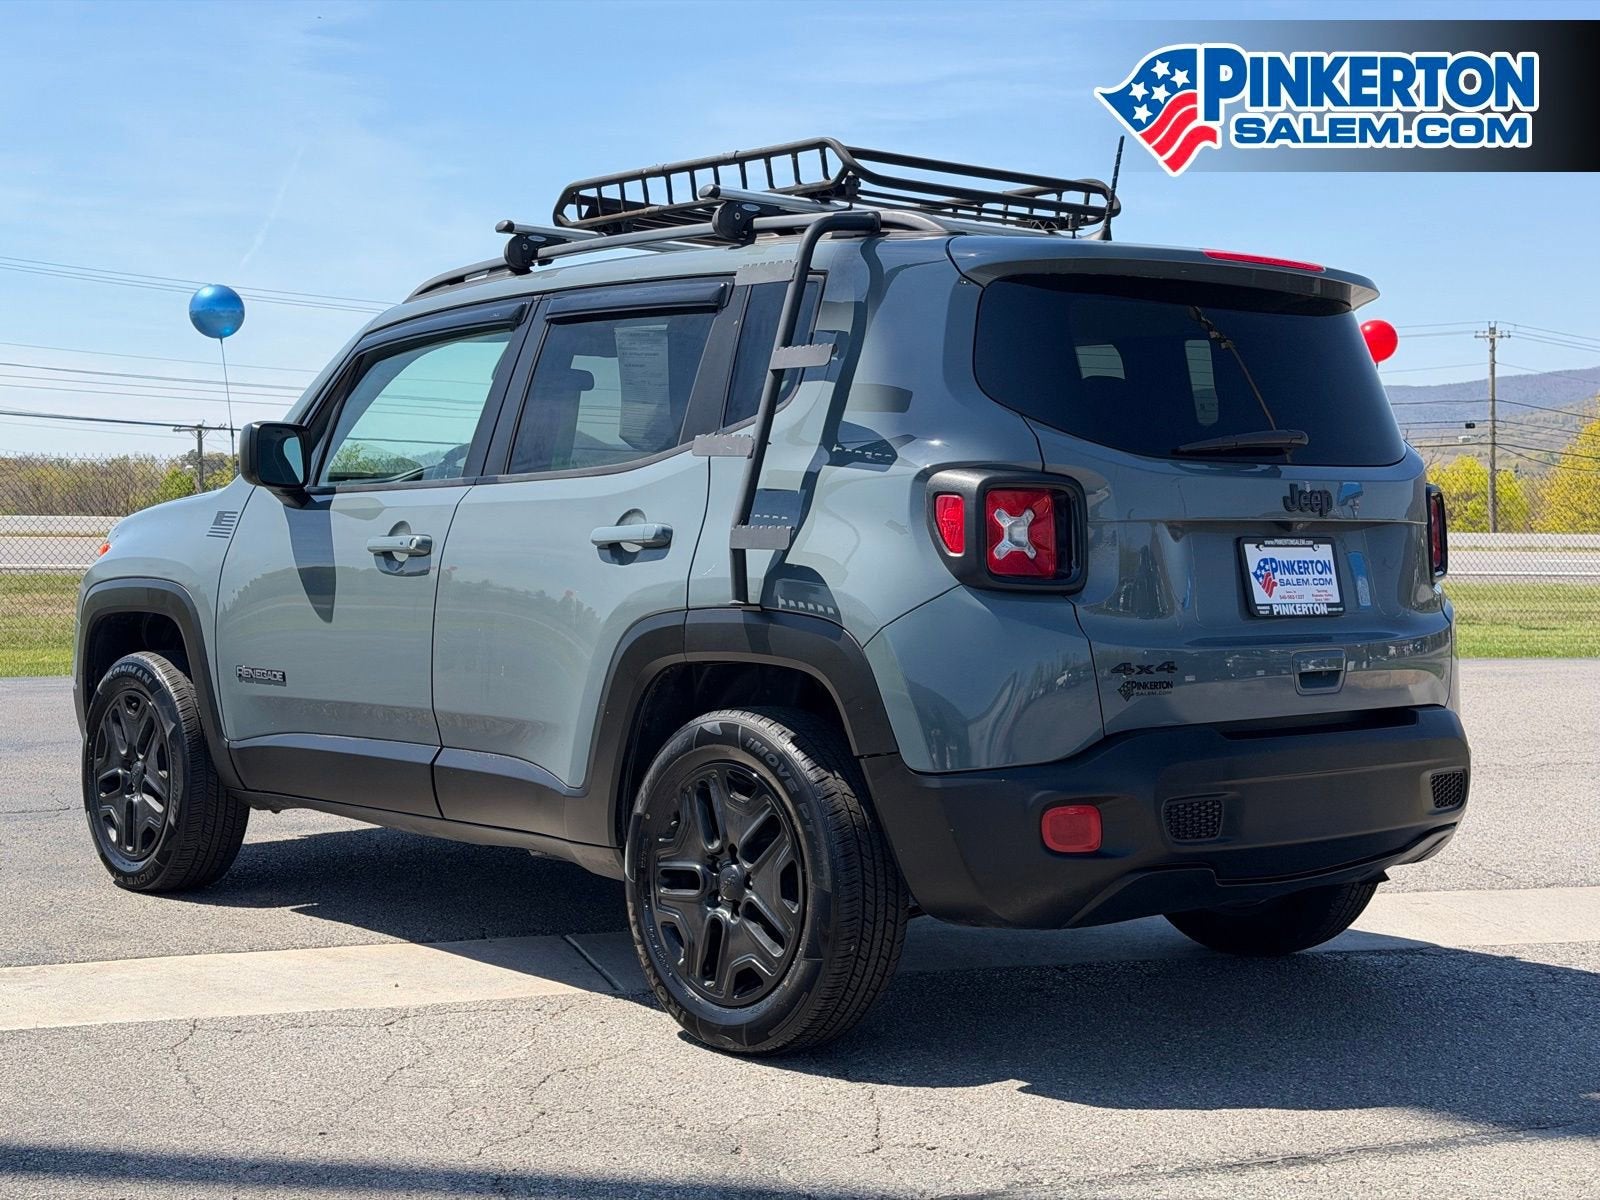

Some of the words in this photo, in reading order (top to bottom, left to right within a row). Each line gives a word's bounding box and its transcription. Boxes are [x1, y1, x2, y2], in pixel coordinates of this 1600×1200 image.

[1283, 484, 1333, 518] Jeep
[1269, 557, 1333, 580] PINKERTON
[1278, 578, 1334, 587] SALEM.COM
[1272, 603, 1328, 616] PINKERTON
[235, 665, 286, 683] RENEGADE
[1131, 680, 1174, 696] PINKERTON
